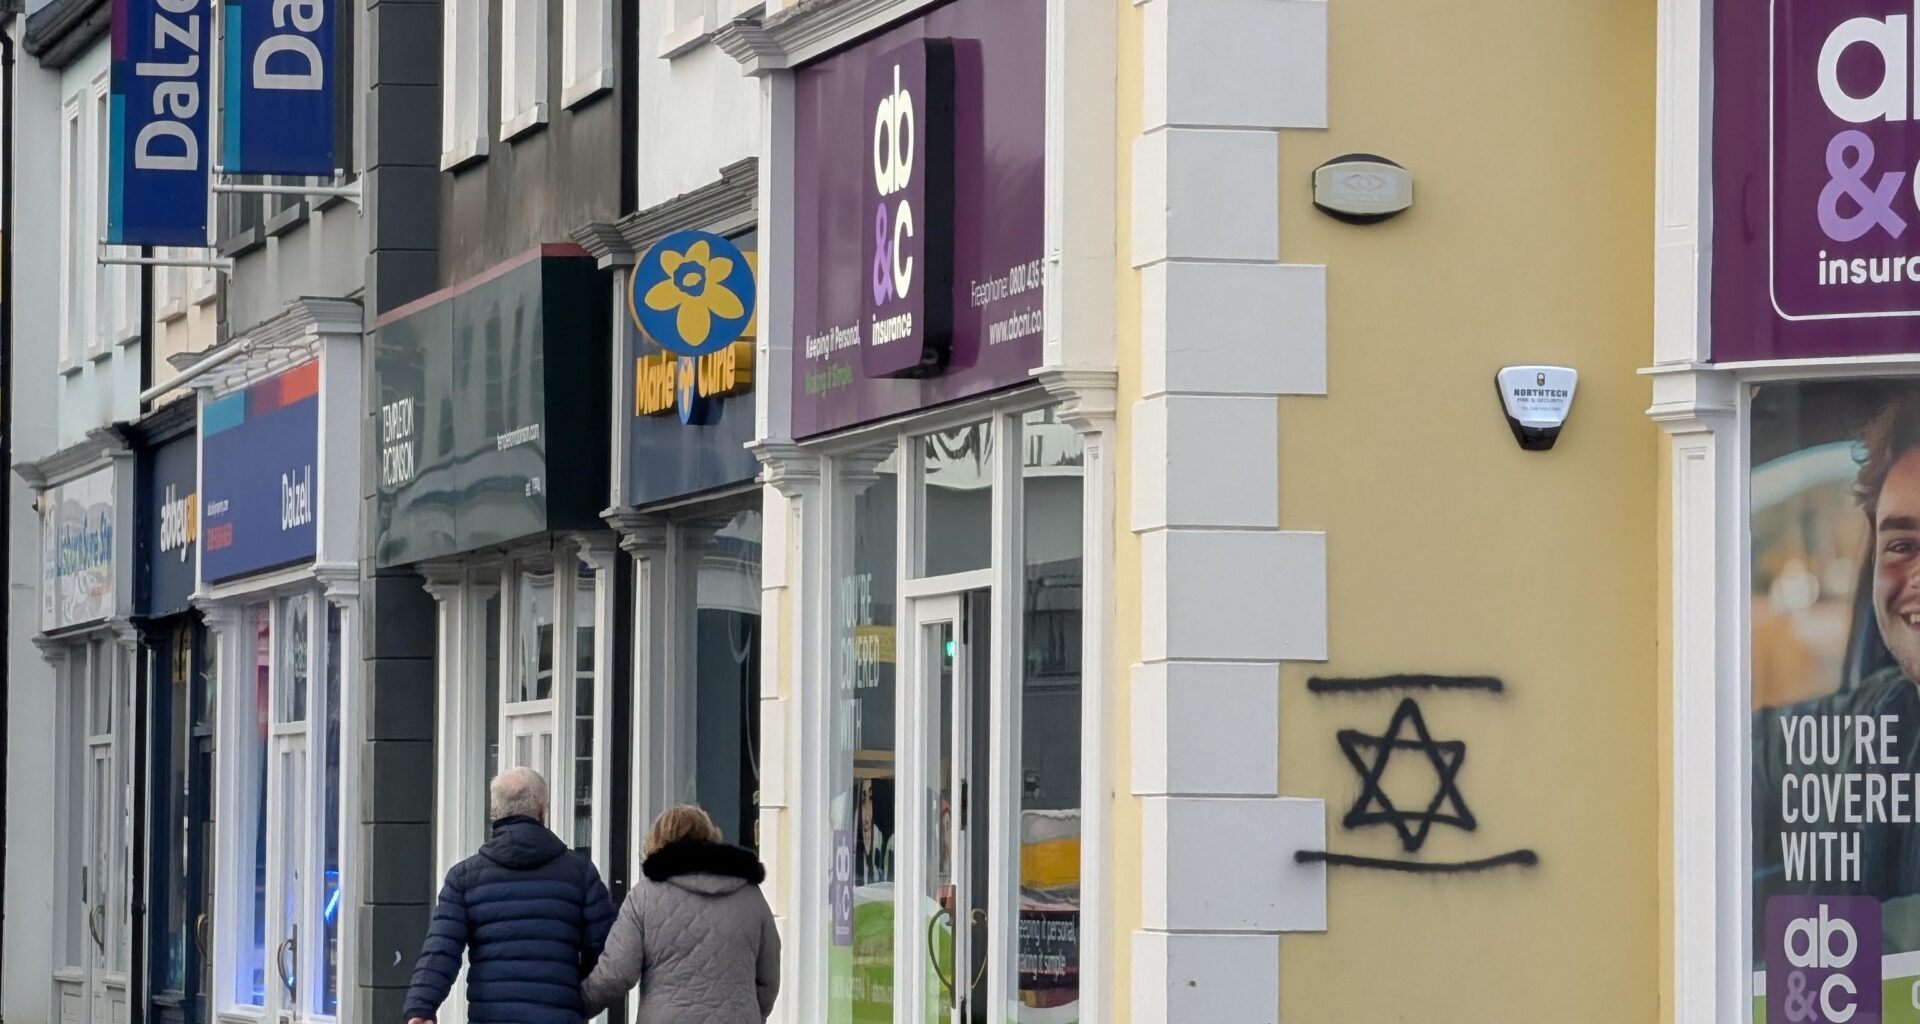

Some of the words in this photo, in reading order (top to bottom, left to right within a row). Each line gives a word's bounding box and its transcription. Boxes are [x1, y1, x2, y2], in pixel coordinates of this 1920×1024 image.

[1817, 0, 1920, 123] a
[873, 63, 914, 197] ab
[971, 272, 1008, 311] Freephone:
[1010, 264, 1026, 296] 0800
[1027, 260, 1040, 290] 435
[805, 331, 829, 361] Keeping
[872, 312, 912, 347] insurance
[636, 349, 675, 417] Marie
[1514, 388, 1568, 398] NORTHTECH
[382, 396, 415, 443] TEMPLETON
[383, 440, 415, 487] ROBINSON
[282, 464, 312, 531] Dalzell
[840, 573, 872, 629] YOU'RE
[840, 634, 880, 690] COVERED
[840, 697, 862, 753] WITH
[1780, 714, 1899, 765] YOU'RE
[1781, 773, 1920, 824] COVERE
[1780, 831, 1861, 882] WITH
[1783, 903, 1858, 969] ab
